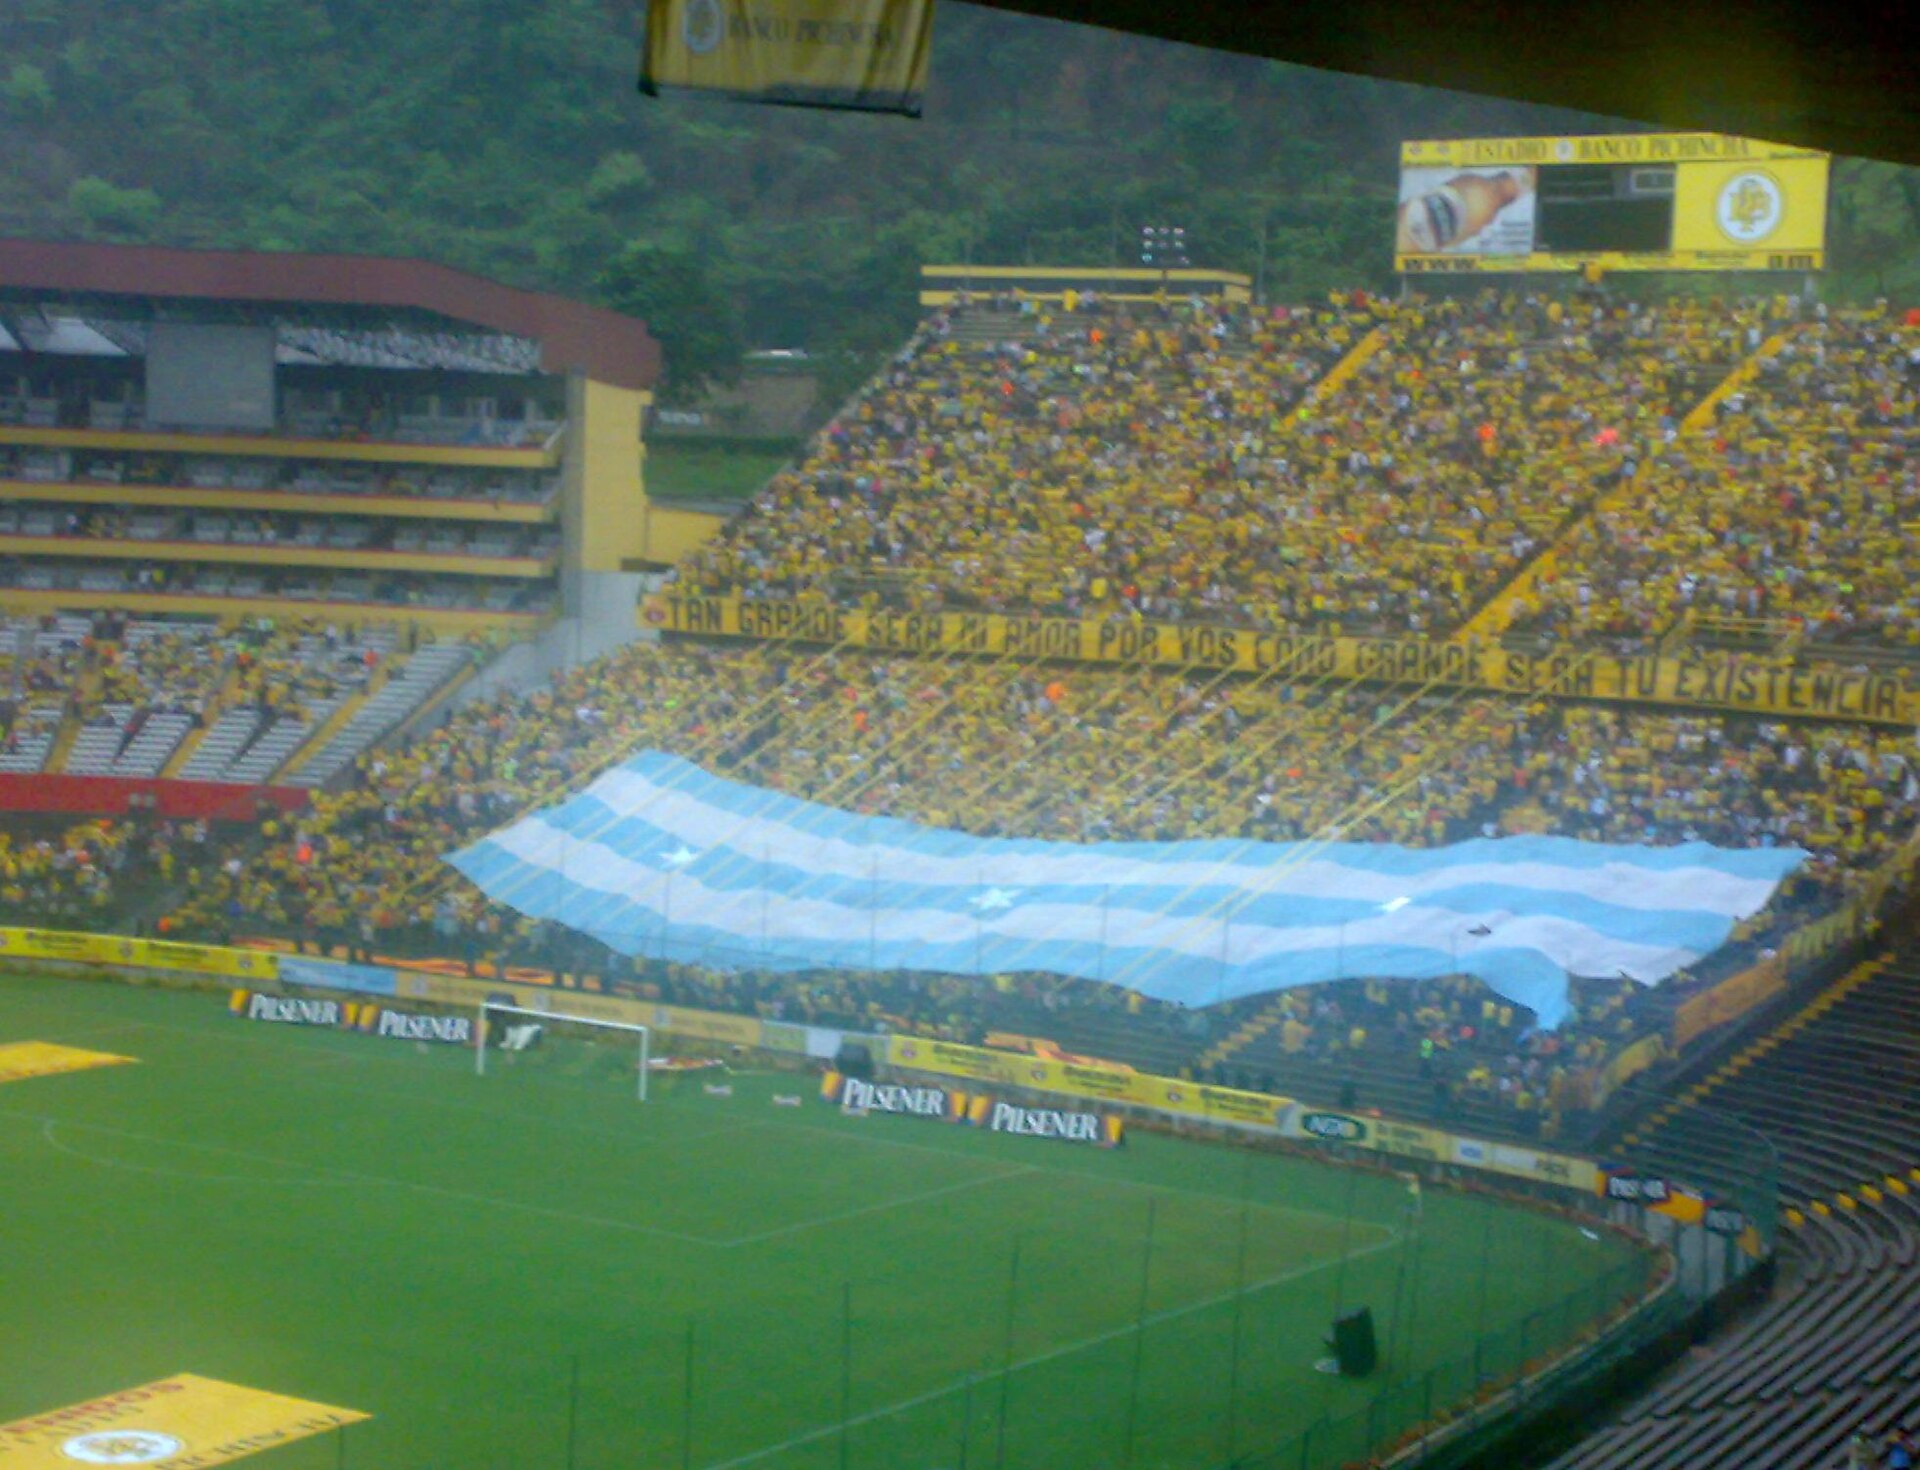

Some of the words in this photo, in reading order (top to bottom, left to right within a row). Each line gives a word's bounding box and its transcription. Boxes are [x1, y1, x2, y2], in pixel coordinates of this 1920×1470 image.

[670, 600, 723, 632] TAN
[738, 601, 845, 641] GRANDE
[1100, 625, 1159, 661] POR
[1178, 628, 1238, 667] VOS
[1254, 634, 1338, 675] COMO
[1355, 640, 1484, 687] GRANDE
[1614, 655, 1660, 697] TU
[1674, 656, 1897, 717] EXISTENCIA
[249, 992, 339, 1025] PILSENER
[378, 1009, 470, 1041] PILSENER
[843, 1077, 945, 1116] PILSENER
[991, 1102, 1099, 1141] PILSENER
